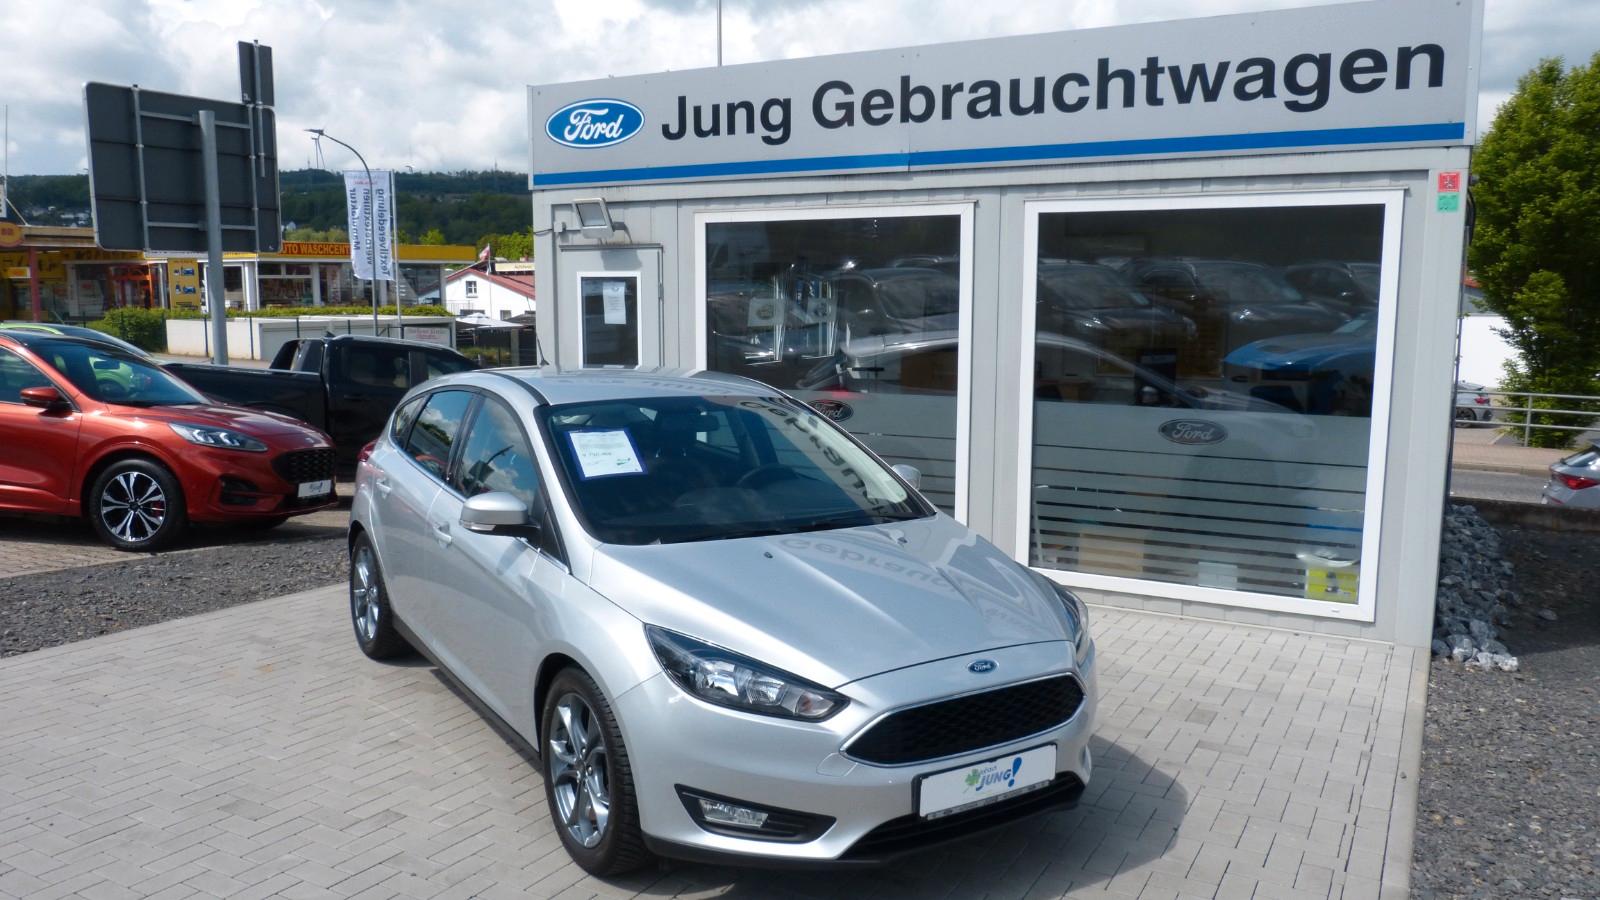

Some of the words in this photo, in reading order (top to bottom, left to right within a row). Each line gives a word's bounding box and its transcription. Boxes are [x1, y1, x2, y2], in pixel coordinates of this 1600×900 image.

[661, 95, 792, 146] Jung
[811, 42, 1446, 130] Gebrauchtwagen
[563, 108, 624, 141] Ford
[1172, 422, 1215, 441] Ford
